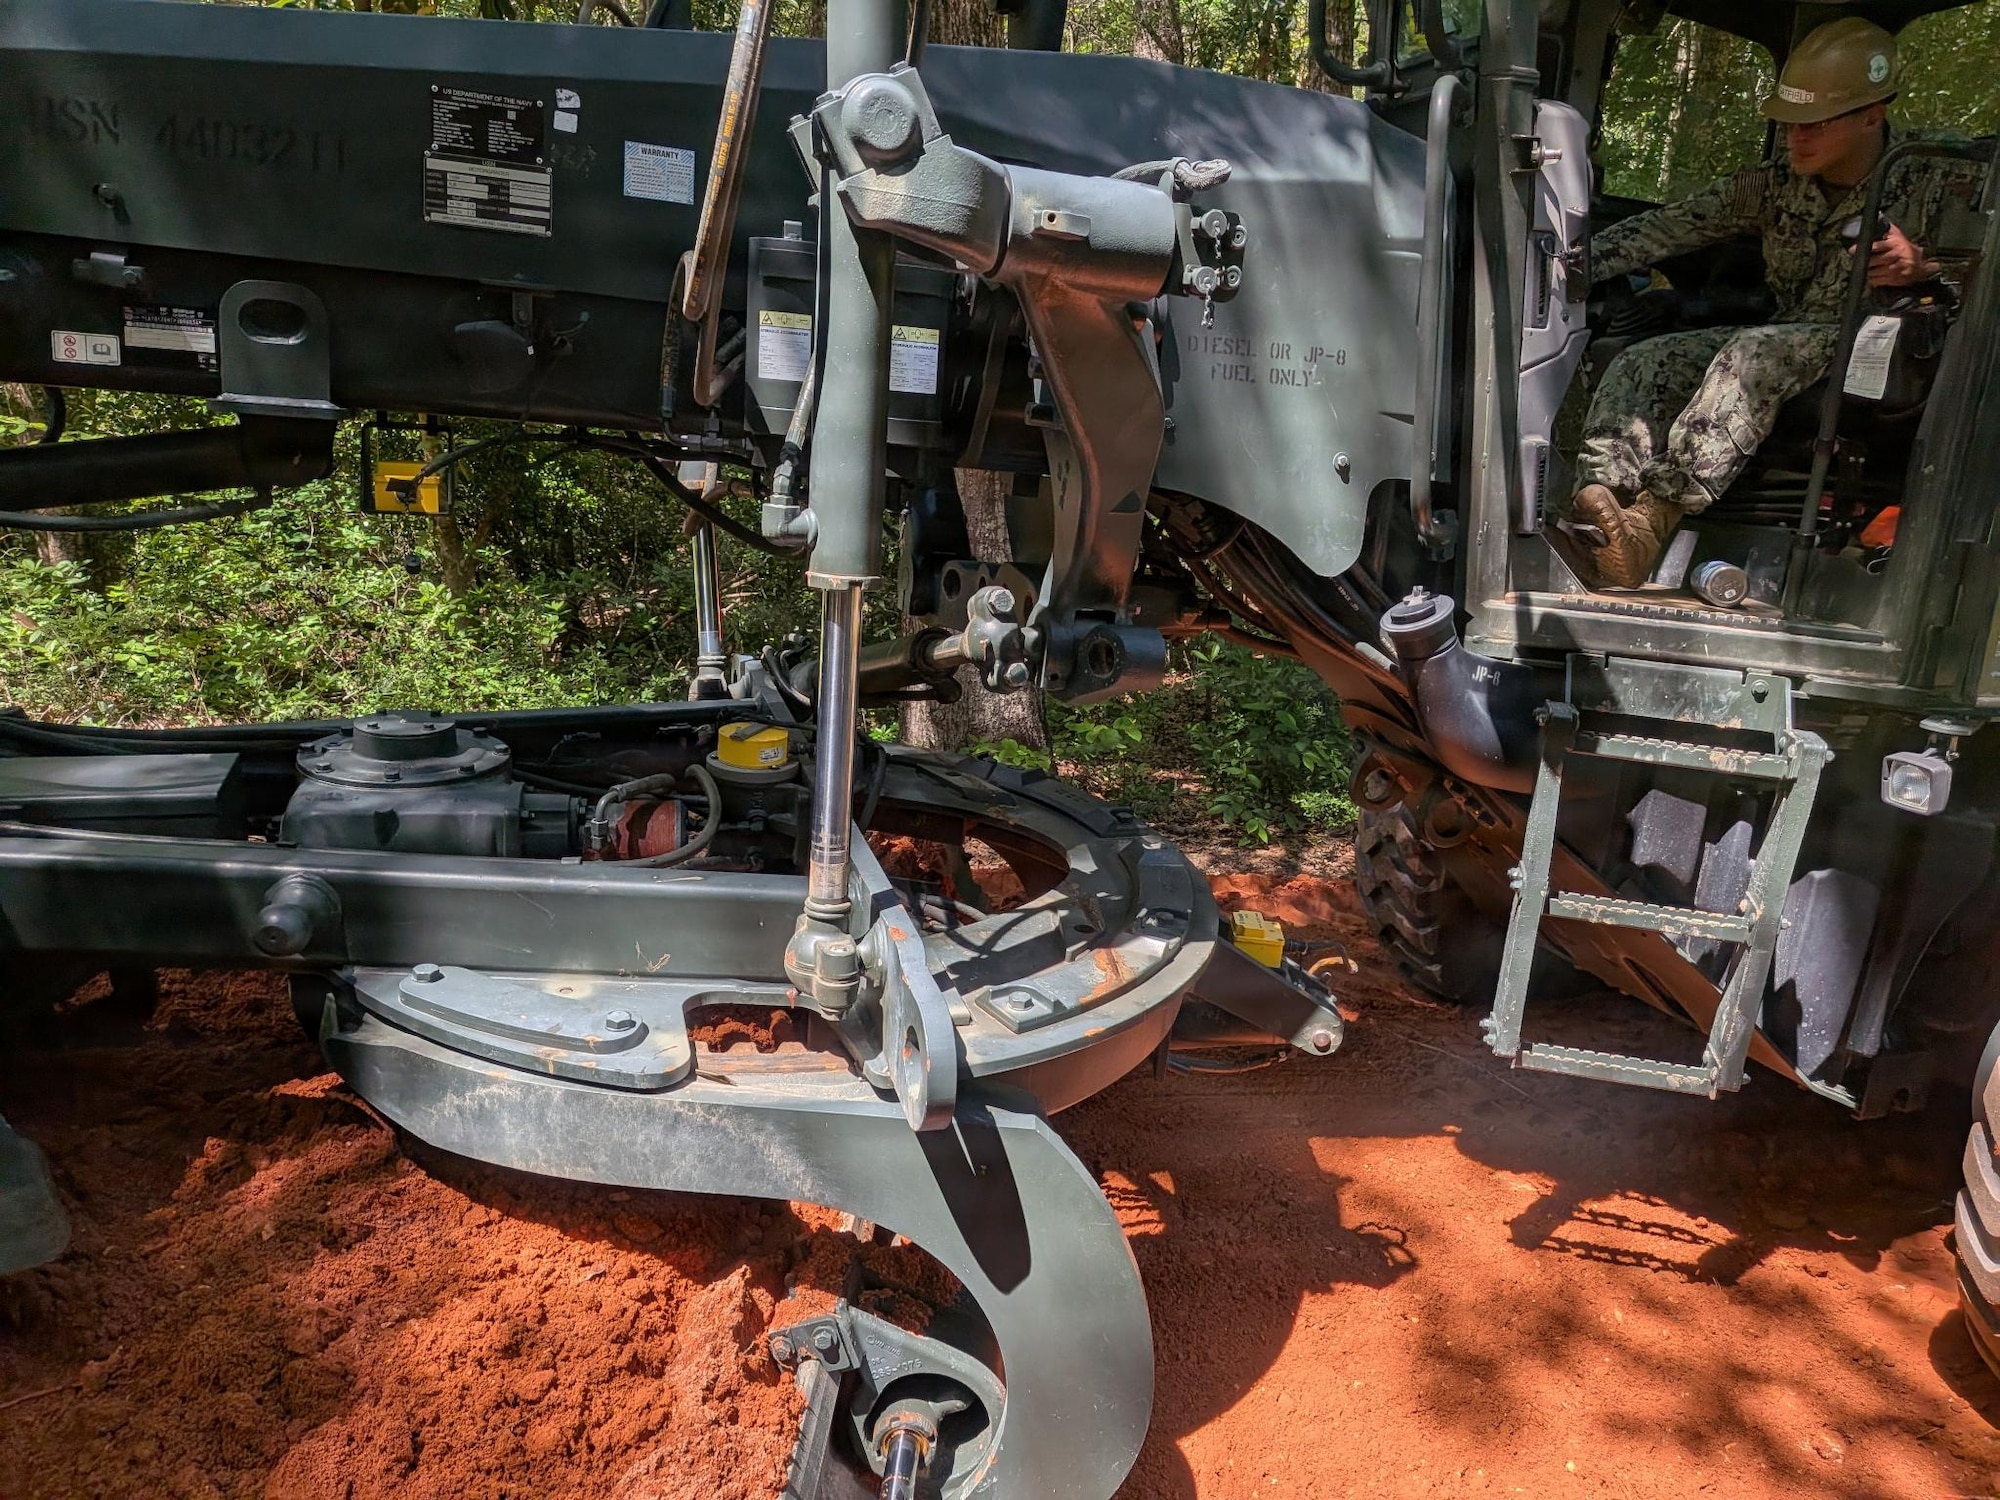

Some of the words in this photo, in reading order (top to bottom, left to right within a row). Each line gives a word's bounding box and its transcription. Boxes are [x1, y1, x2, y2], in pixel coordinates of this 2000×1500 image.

[453, 89, 493, 101] DEPARTMENT
[516, 98, 533, 107] NAVY
[641, 147, 680, 159] WARRANTY
[1187, 335, 1257, 358] DIESEL
[1270, 341, 1292, 360] OR
[1304, 346, 1347, 366] JP-8
[1211, 362, 1257, 384] FUEL
[1269, 367, 1314, 387] ONLY
[1472, 665, 1501, 686] JP-8
